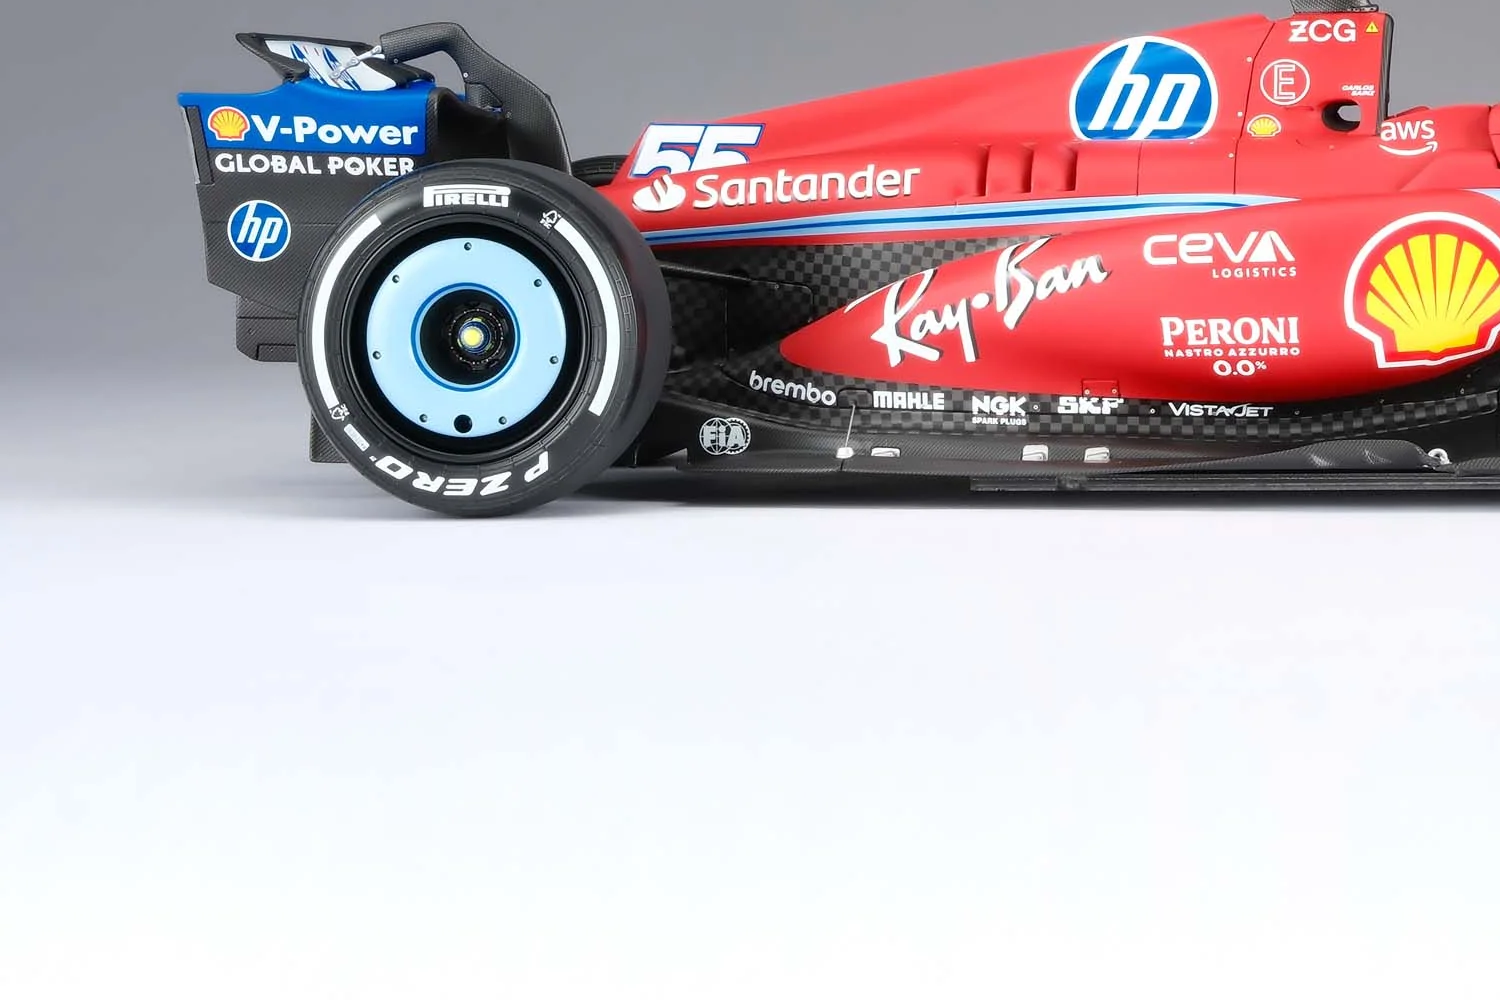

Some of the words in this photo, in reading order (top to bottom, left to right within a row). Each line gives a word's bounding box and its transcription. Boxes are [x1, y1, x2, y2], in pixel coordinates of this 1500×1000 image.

[1288, 19, 1357, 42] ZCG
[1087, 36, 1201, 140] hp
[251, 115, 419, 145] V-Power
[1380, 119, 1436, 141] aws
[629, 123, 765, 178] 55
[214, 153, 322, 175] GLOBAL
[327, 156, 415, 177] POKER
[423, 184, 512, 208] PIRELLI
[693, 164, 921, 209] Santander
[237, 200, 283, 260] hp
[1143, 230, 1296, 266] CEVA
[1212, 266, 1297, 279] LOGISTICS
[1160, 316, 1299, 346] PERONI
[1164, 348, 1224, 358] NASTRO
[1227, 347, 1300, 357] AZZURRO
[1212, 359, 1267, 377] 0.0%
[750, 370, 837, 406] brembo
[872, 390, 945, 411] MAHLE
[971, 395, 1028, 416] NGK
[1057, 396, 1124, 415] SKF
[1168, 402, 1274, 418] VISTAJET
[971, 416, 999, 425] SPARK
[1000, 416, 1028, 426] PLUGS
[374, 455, 513, 497] ZERO
[524, 450, 549, 483] P
